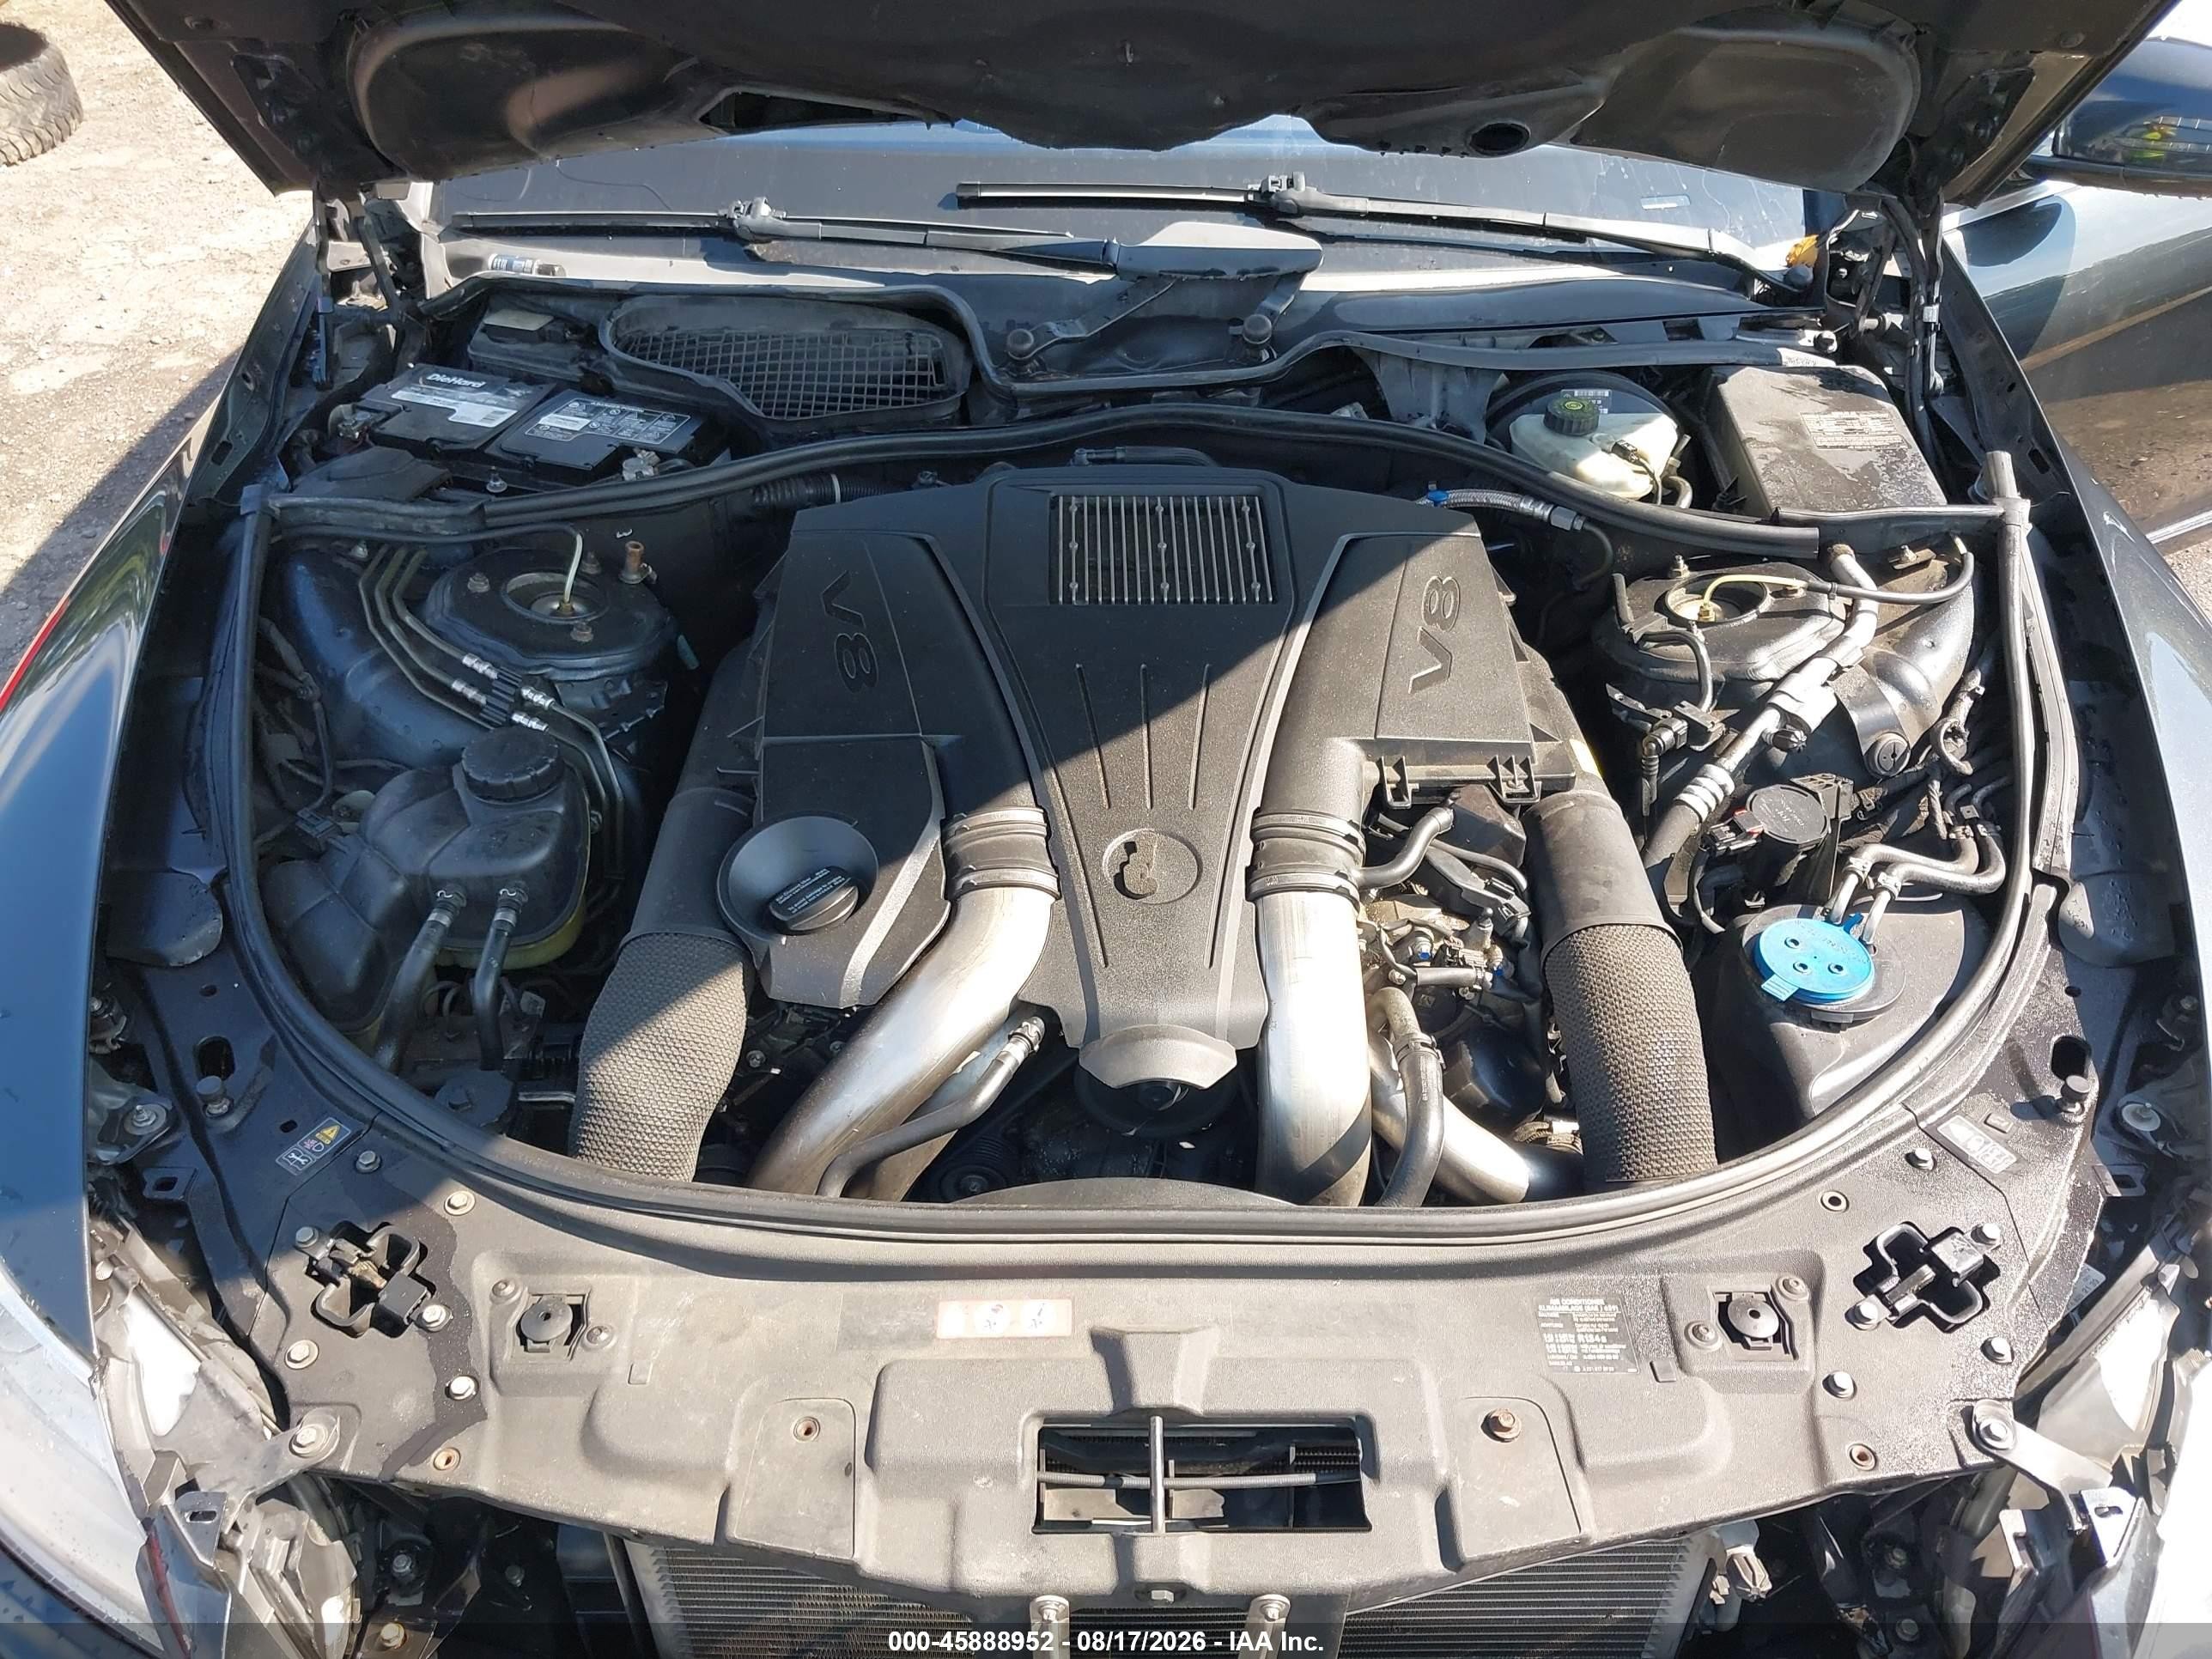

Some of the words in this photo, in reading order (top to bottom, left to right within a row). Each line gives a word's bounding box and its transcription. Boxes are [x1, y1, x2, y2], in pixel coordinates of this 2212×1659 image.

[427, 373, 486, 388] DieHard
[820, 569, 879, 694] V8
[1407, 575, 1461, 694] V8
